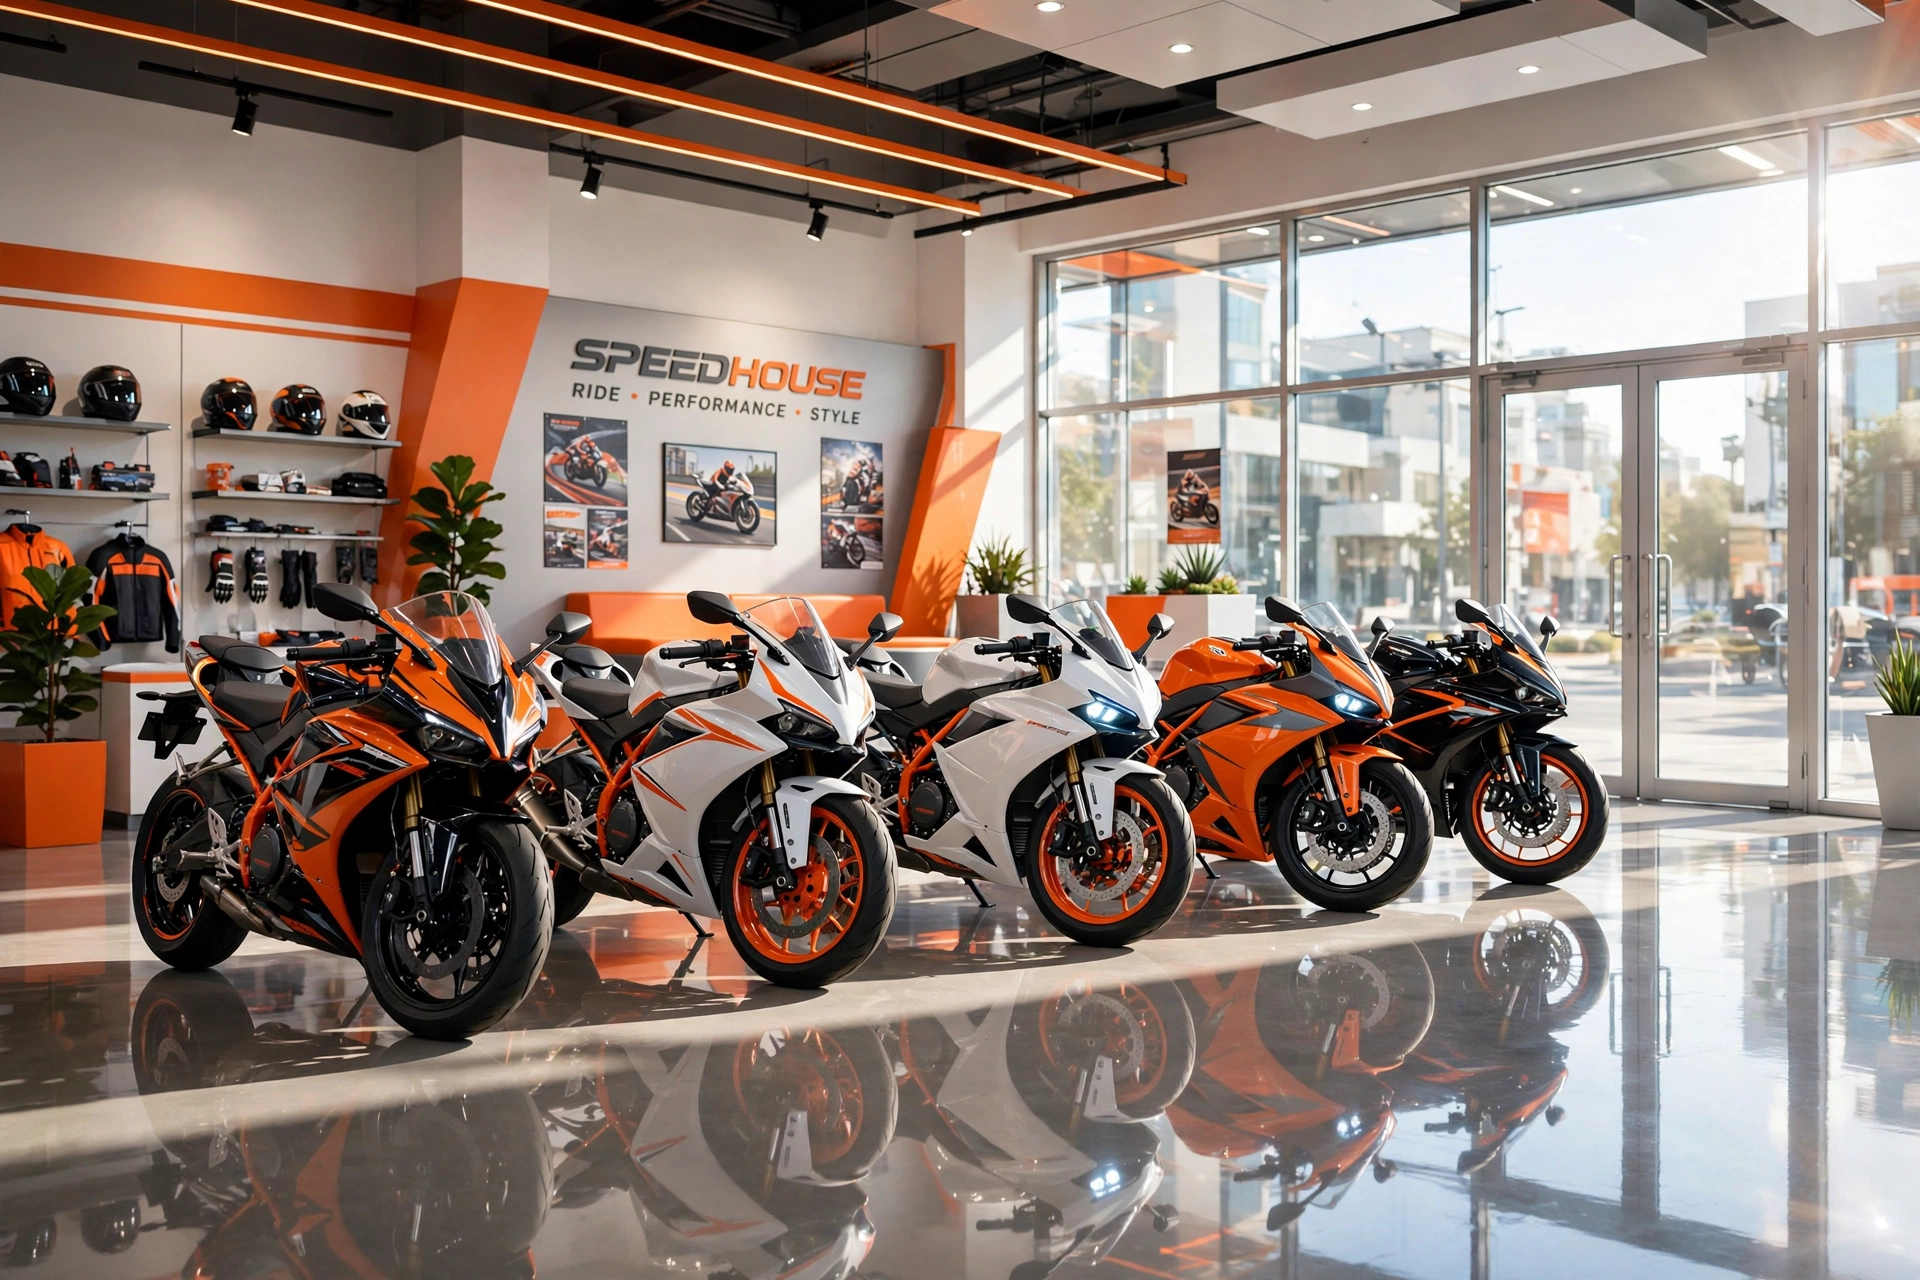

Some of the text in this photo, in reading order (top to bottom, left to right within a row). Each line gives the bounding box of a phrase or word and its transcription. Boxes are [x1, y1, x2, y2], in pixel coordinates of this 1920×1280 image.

[570, 338, 867, 400] SPEEDHOUSE
[572, 382, 861, 425] RIDE PERFORMANCE STYLE
